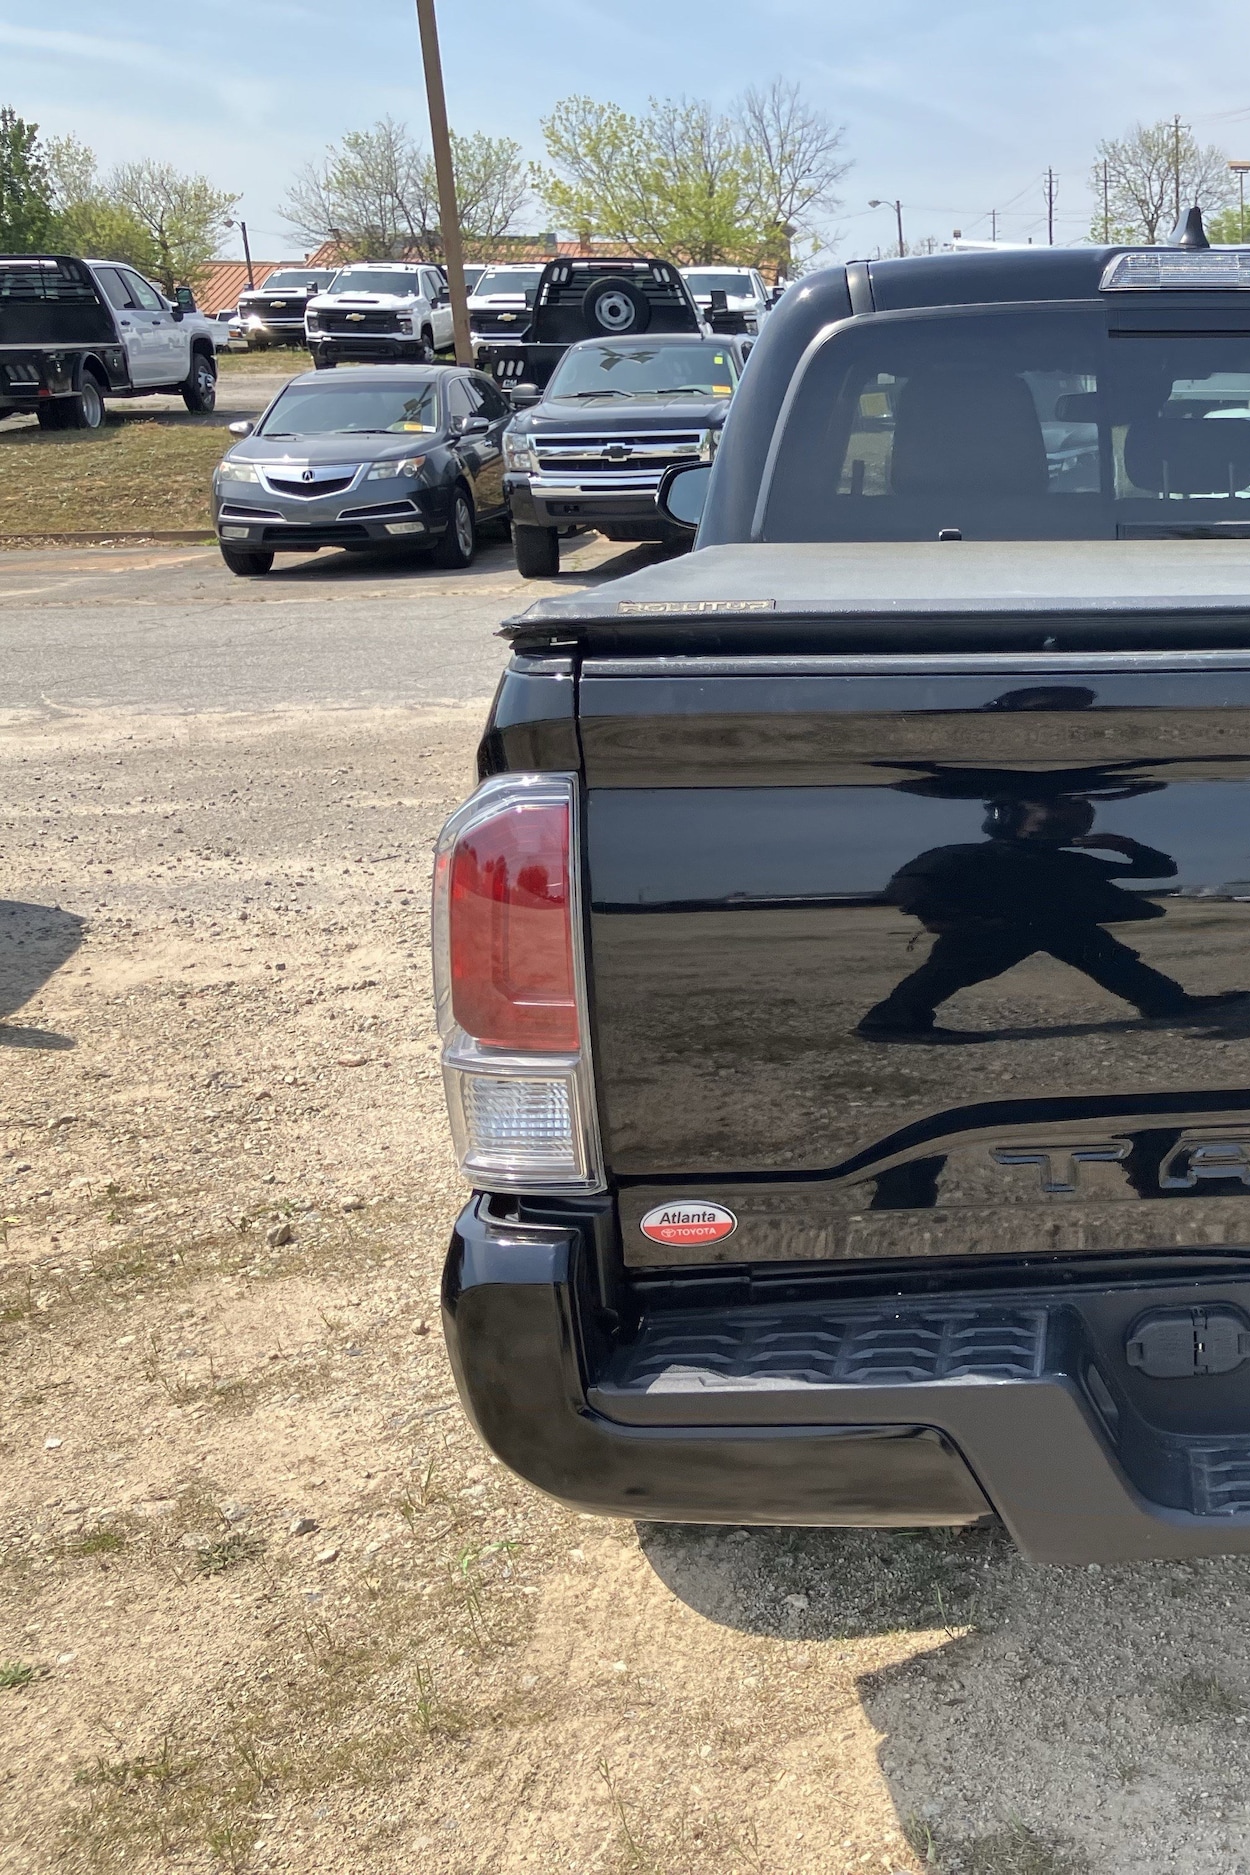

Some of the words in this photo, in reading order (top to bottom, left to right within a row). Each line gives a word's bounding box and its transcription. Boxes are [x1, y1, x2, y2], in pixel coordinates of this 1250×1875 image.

[620, 601, 771, 613] ROLLITUP
[659, 1211, 716, 1225] Atlanta
[677, 1227, 716, 1236] TOYOTA
